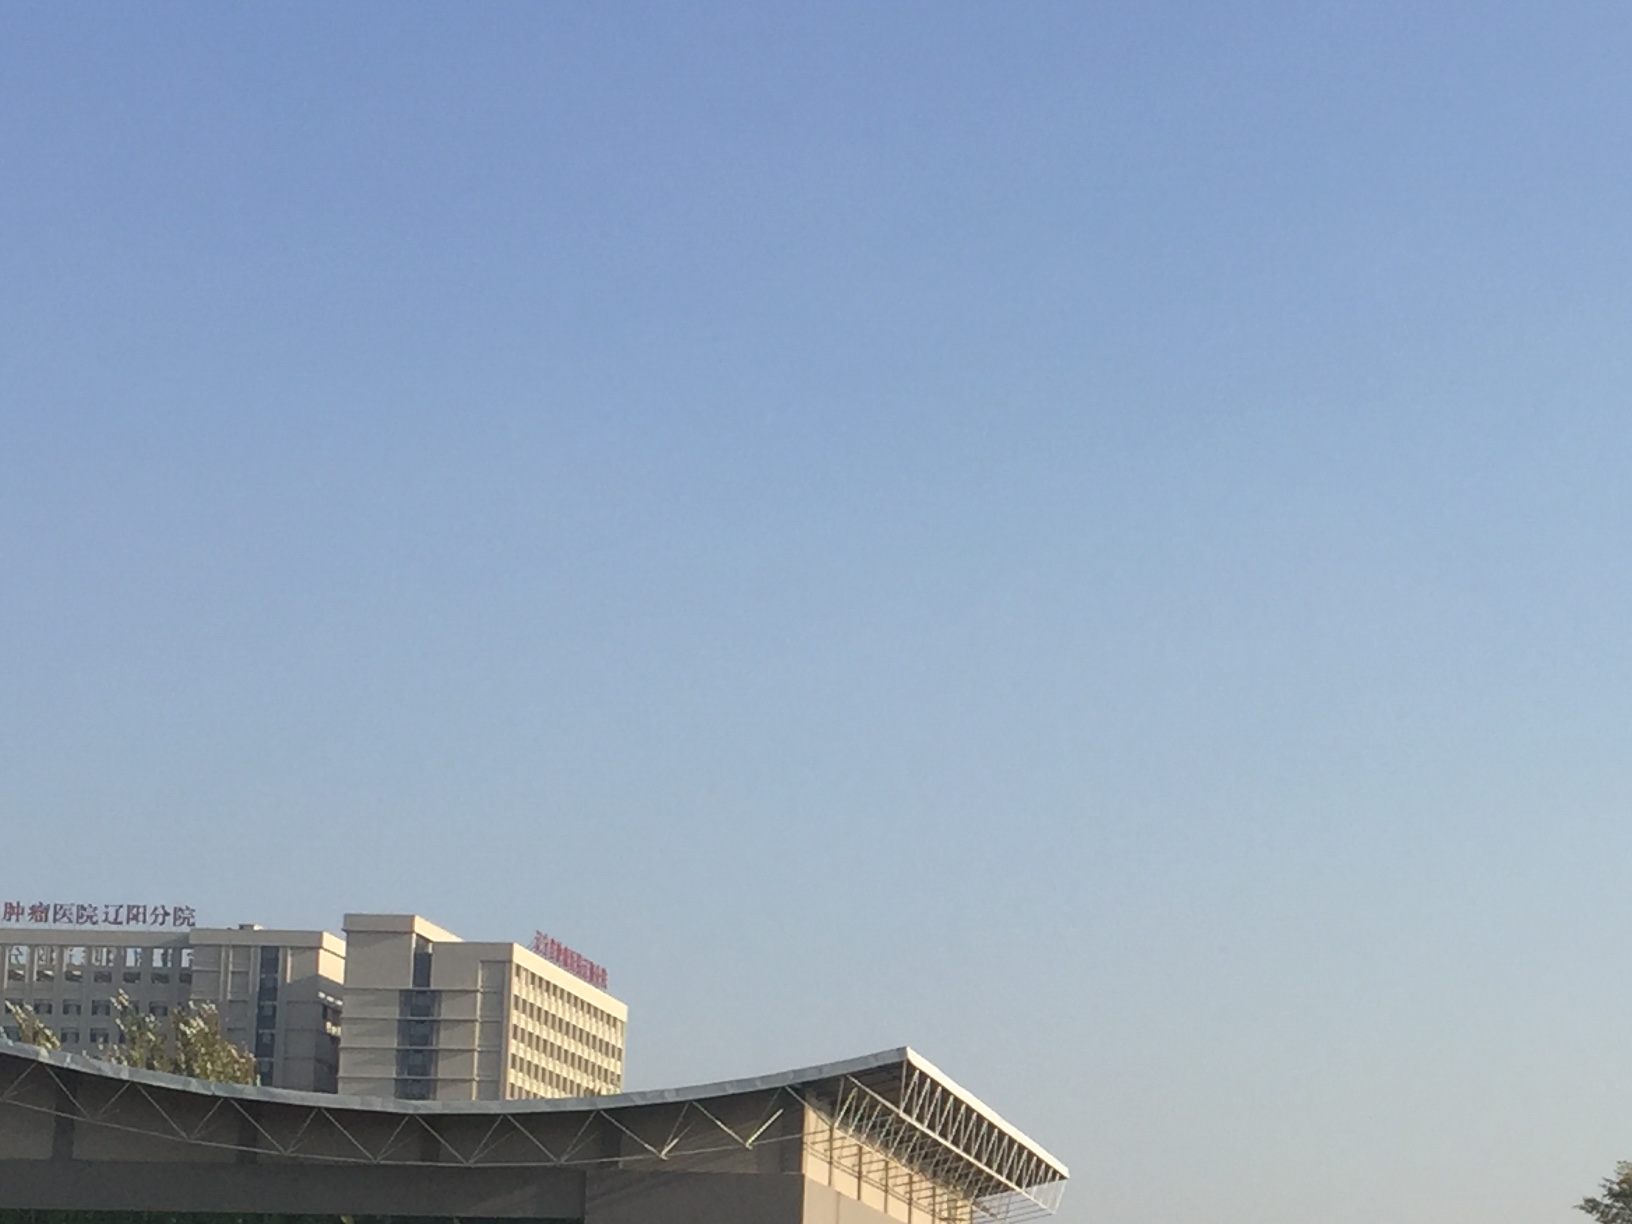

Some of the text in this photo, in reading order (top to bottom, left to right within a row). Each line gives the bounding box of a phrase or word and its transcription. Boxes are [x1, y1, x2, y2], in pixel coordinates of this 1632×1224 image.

[2, 900, 197, 927] 肿瘤医院辽阳分院
